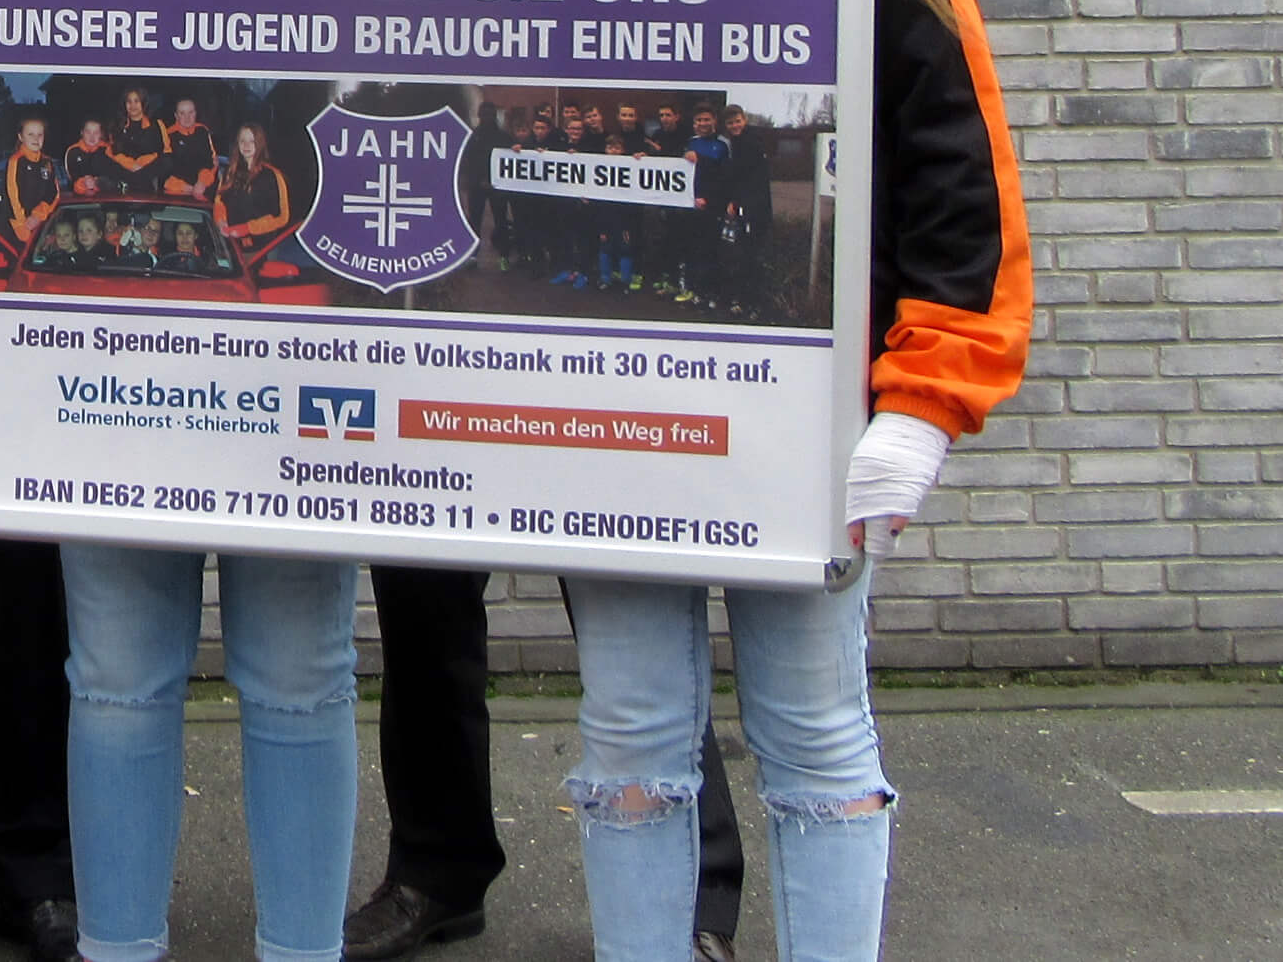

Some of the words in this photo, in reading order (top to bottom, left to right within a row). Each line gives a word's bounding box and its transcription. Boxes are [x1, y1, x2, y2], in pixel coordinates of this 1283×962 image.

[171, 11, 338, 54] JUGEND
[354, 14, 557, 59] BRAUCHT
[572, 20, 703, 62] EINEN
[721, 23, 811, 65] BUS
[329, 128, 447, 160] JAHN
[499, 157, 586, 185] HELFEN
[594, 164, 631, 189] SIE
[639, 169, 687, 193] UNS
[315, 234, 457, 274] DELMENHORST
[11, 323, 85, 349] Jeden
[93, 326, 270, 359] Spenden-Euro
[277, 337, 358, 363] stockt
[366, 340, 406, 365] die
[414, 342, 552, 373] Volksbank
[561, 350, 605, 375] mit
[614, 352, 648, 377] 30
[657, 354, 717, 380] Cent
[726, 358, 778, 383] auf.
[57, 374, 227, 411] Volksbank
[236, 386, 280, 413] eG
[58, 407, 172, 429] Delmenhorst
[185, 414, 280, 435] Schierbrok
[422, 409, 461, 430] Wir
[467, 414, 556, 436] machen
[562, 417, 605, 439] den
[612, 421, 663, 446] Weg
[670, 422, 715, 445] frei.
[279, 456, 474, 492] Spendenkonto:
[14, 477, 73, 503] IBAN
[82, 481, 145, 508] DE62
[153, 486, 216, 512] 2806
[225, 491, 288, 517] 7170
[297, 495, 358, 521] 0051
[370, 500, 435, 527] 8883
[445, 505, 474, 530] 11
[510, 508, 555, 534] BIC
[563, 510, 759, 548] GENODEF1GSC
